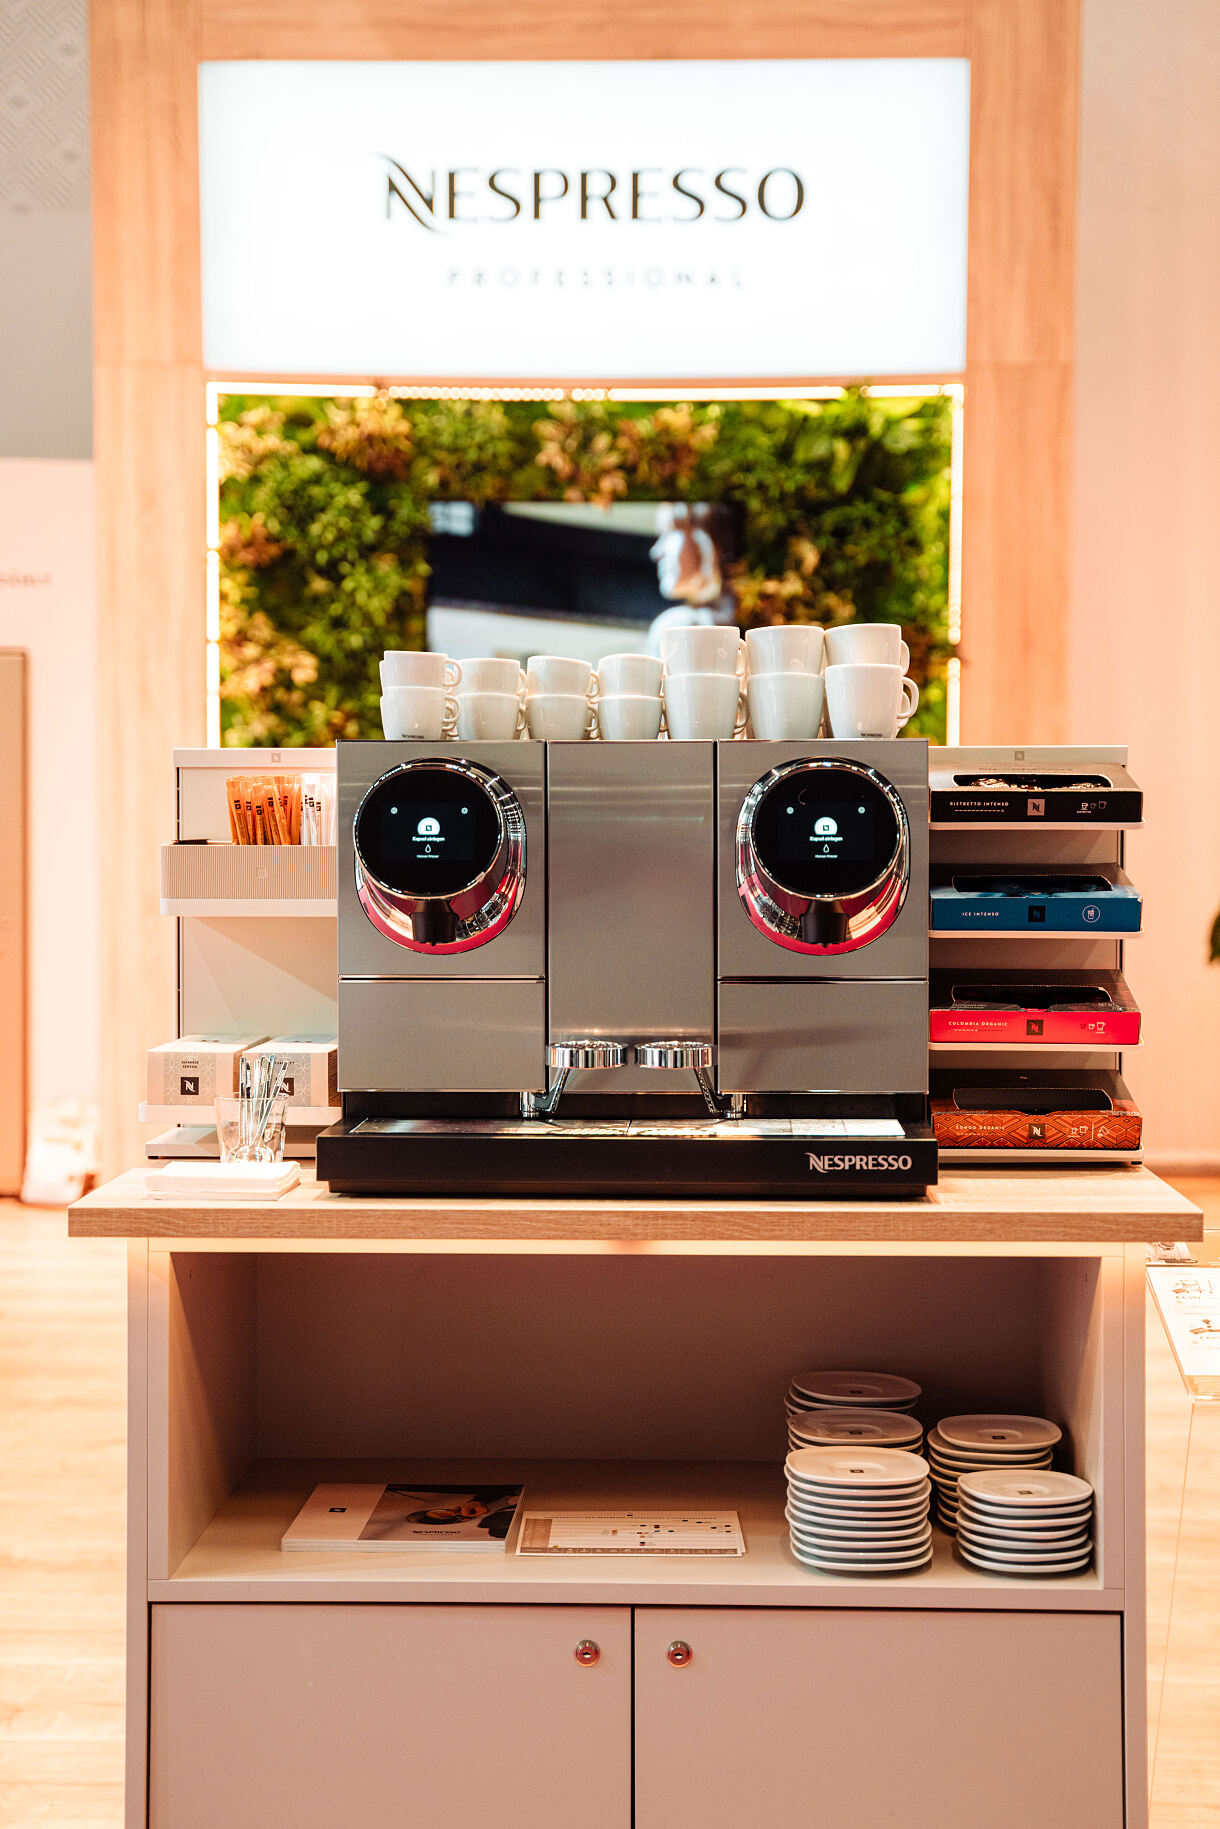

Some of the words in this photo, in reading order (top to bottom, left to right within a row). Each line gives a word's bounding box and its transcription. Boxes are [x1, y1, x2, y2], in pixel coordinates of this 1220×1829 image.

[373, 153, 805, 235] NESPRESSO
[448, 267, 746, 288] PROFESSIONAL
[804, 1152, 913, 1174] NESPRESSO
